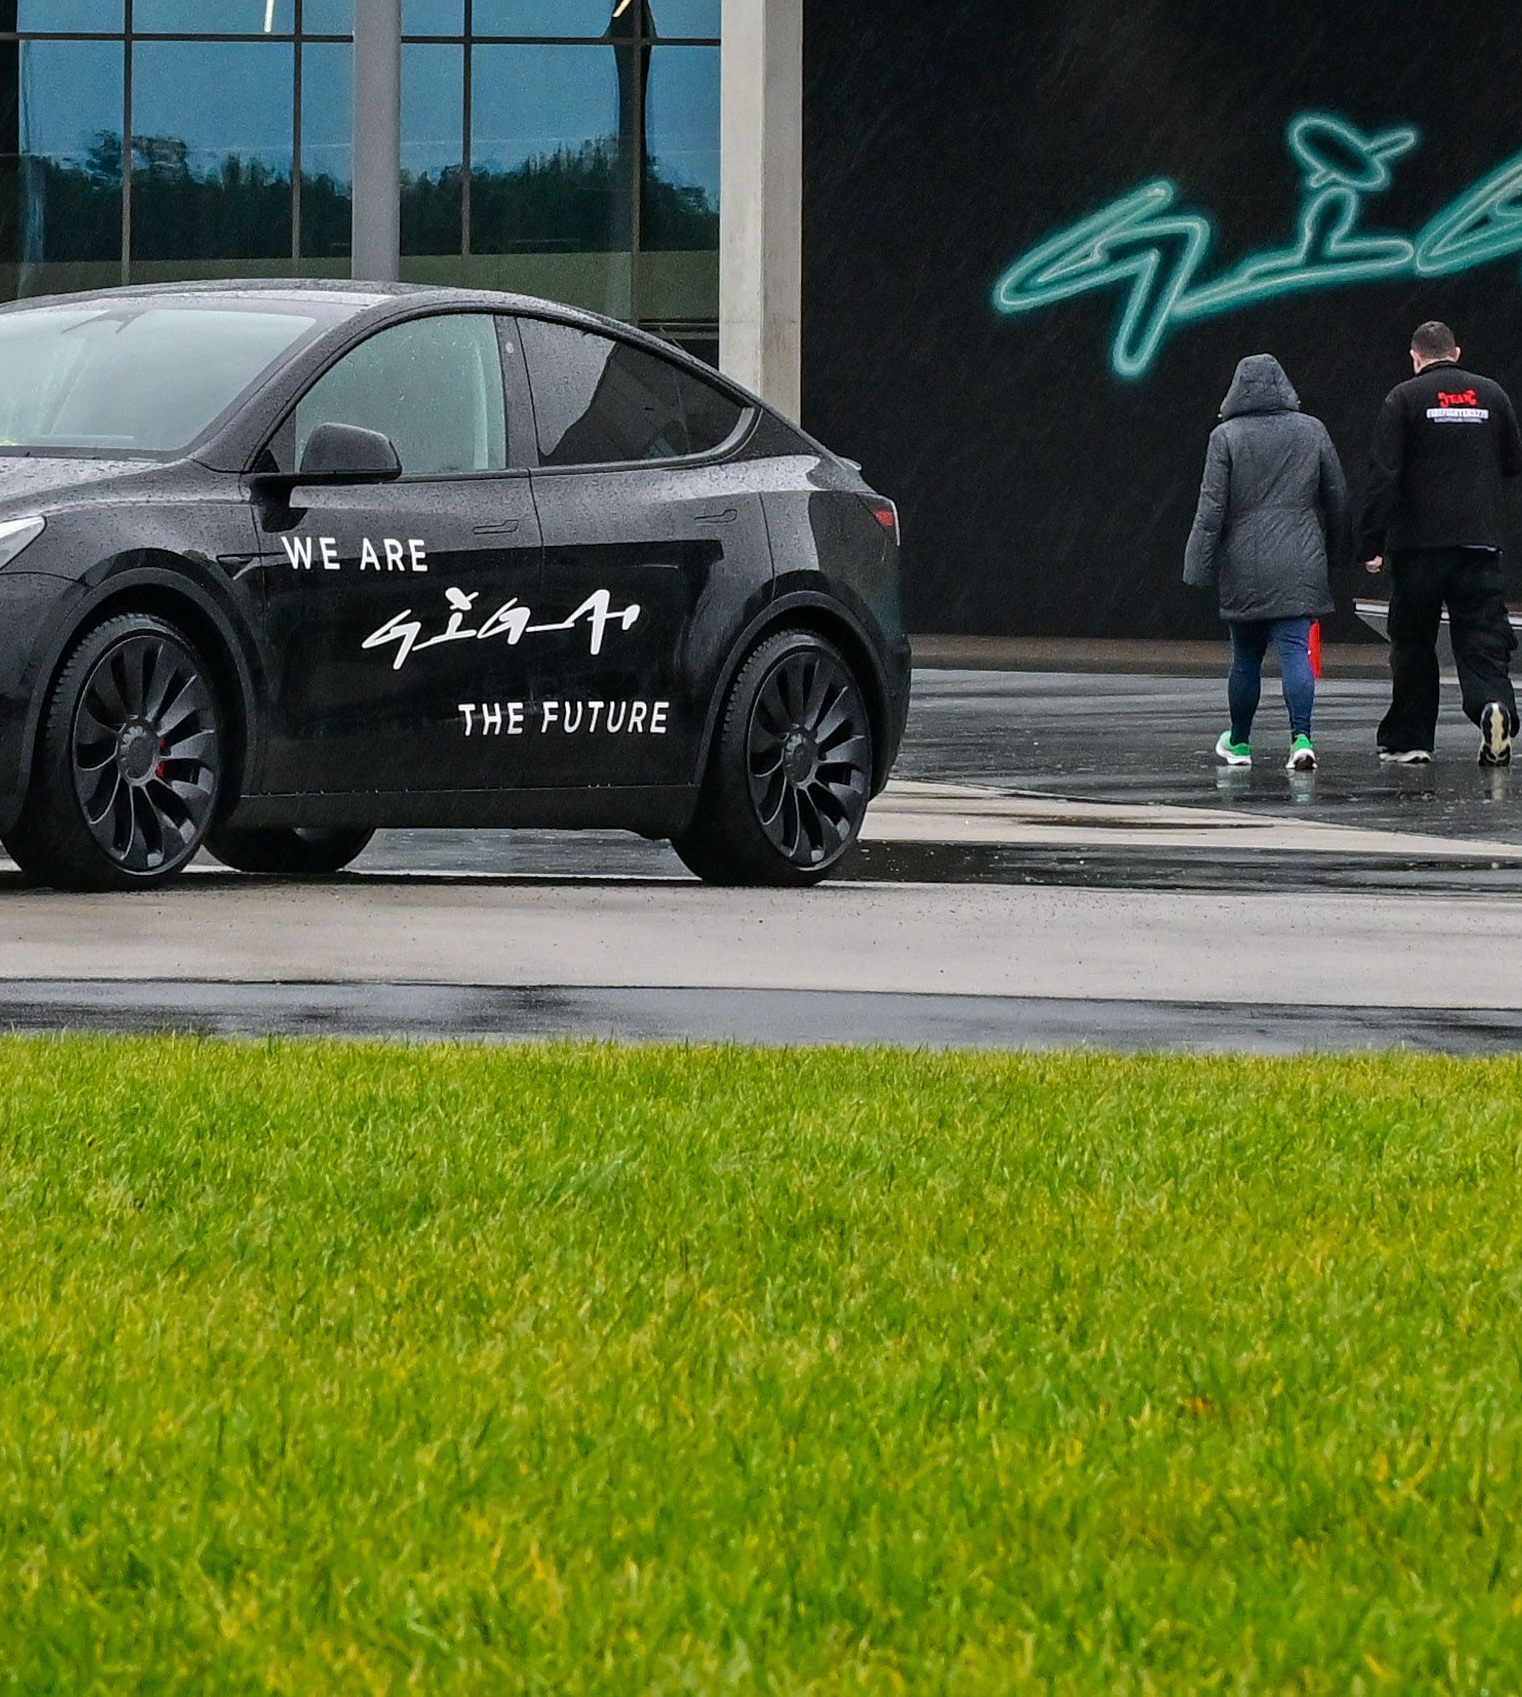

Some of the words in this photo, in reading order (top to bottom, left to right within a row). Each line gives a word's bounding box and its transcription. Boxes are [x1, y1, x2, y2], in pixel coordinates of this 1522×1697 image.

[280, 535, 341, 571] WE
[359, 537, 428, 572] ARE
[458, 702, 524, 737] THE
[540, 701, 670, 735] FUTURE
